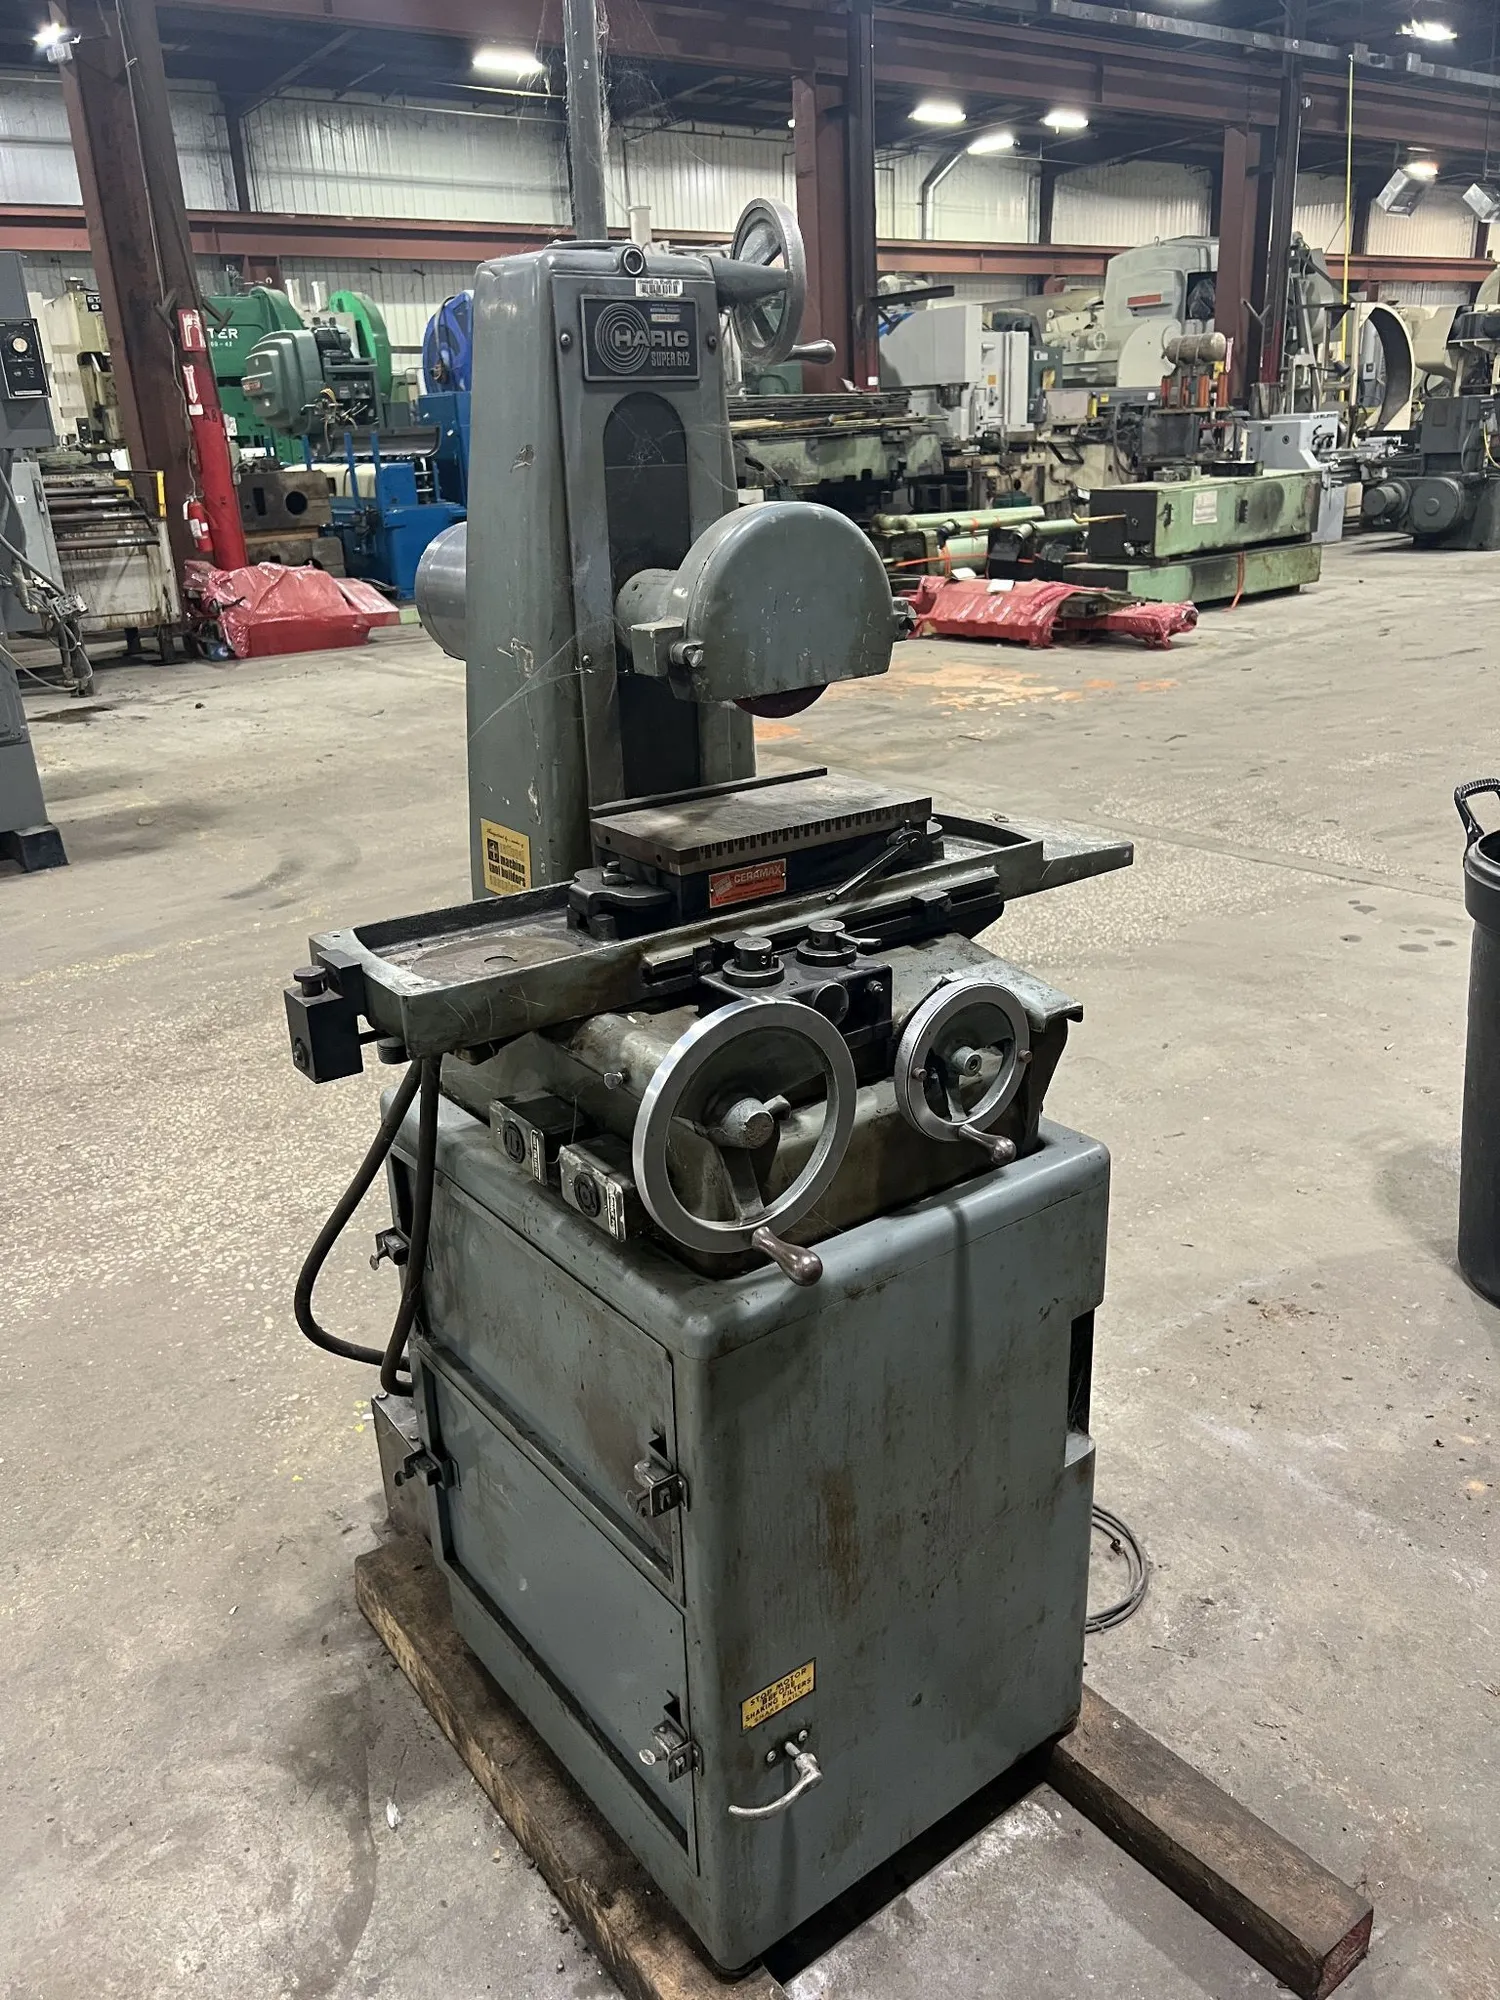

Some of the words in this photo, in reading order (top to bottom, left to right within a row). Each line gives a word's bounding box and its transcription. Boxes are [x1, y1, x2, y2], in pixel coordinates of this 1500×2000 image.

[614, 330, 690, 348] HARIG
[651, 351, 676, 367] SUPER
[677, 352, 691, 366] 612
[733, 865, 781, 884] CERAMAX
[750, 1688, 773, 1707] STOP
[775, 1667, 807, 1691] MOTOR
[762, 1681, 796, 1706] BEFORE
[745, 1699, 779, 1722] SHAKING
[782, 1677, 812, 1699] FILTERS
